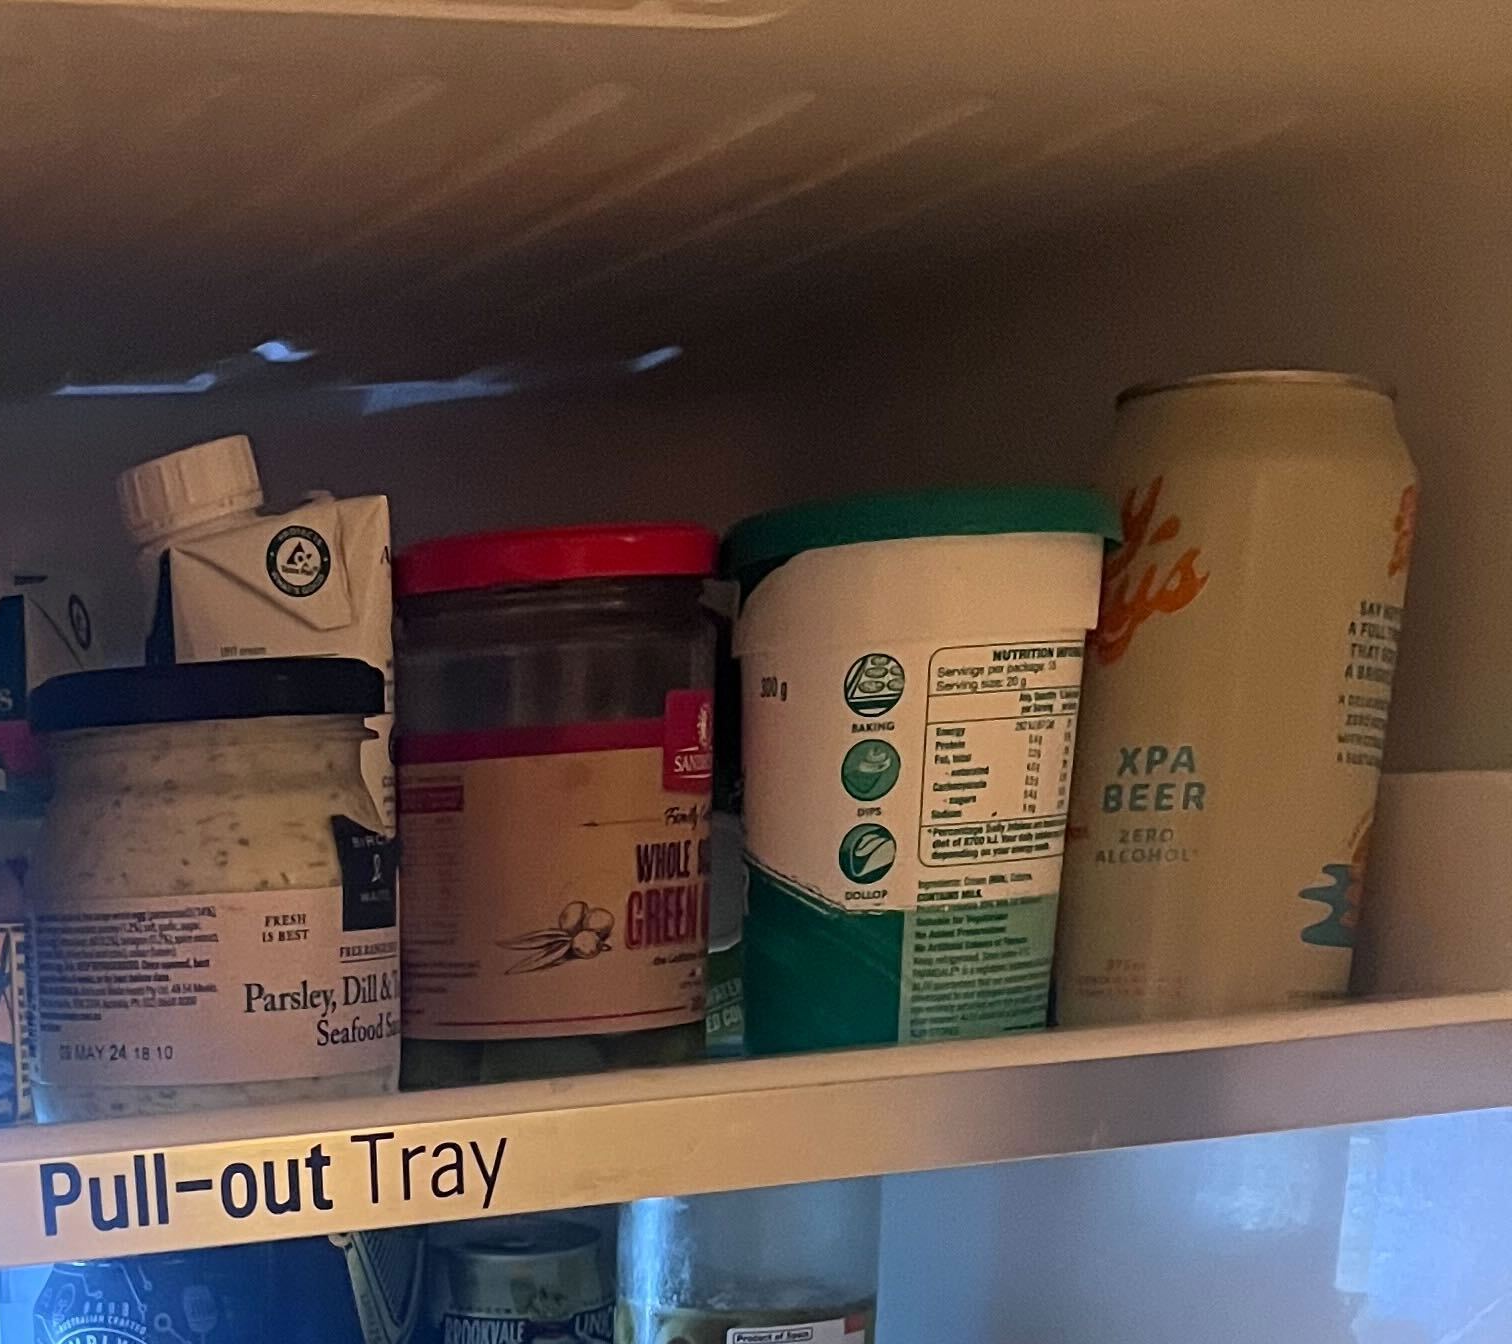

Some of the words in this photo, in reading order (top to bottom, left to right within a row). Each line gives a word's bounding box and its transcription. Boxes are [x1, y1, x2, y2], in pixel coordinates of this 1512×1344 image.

[992, 648, 1054, 661] NUTRITION
[937, 664, 985, 678] Servings
[779, 680, 788, 702] g
[936, 679, 979, 693] Serving
[851, 721, 895, 734] BAKING
[1116, 744, 1197, 777] XPA
[1101, 780, 1207, 814] BEER
[856, 806, 883, 818] DIPS
[1118, 827, 1175, 845] ZERO
[635, 840, 692, 883] WHOLE
[1095, 849, 1191, 865] ALCOHOL
[844, 889, 888, 901] DOLLOP
[265, 913, 307, 927] FRESH
[262, 931, 274, 943] IS
[278, 929, 310, 943] BEST
[243, 980, 337, 1018] Parsley,
[342, 973, 378, 1007] Dill
[379, 972, 392, 1000] &
[316, 1012, 384, 1047] Seafood
[73, 1044, 105, 1061] MAY
[109, 1044, 127, 1061] 24
[156, 1045, 175, 1060] 10
[38, 1142, 335, 1237] Pull-out
[350, 1130, 508, 1210] Tray
[736, 1333, 772, 1343] Product
[774, 1331, 784, 1340] of
